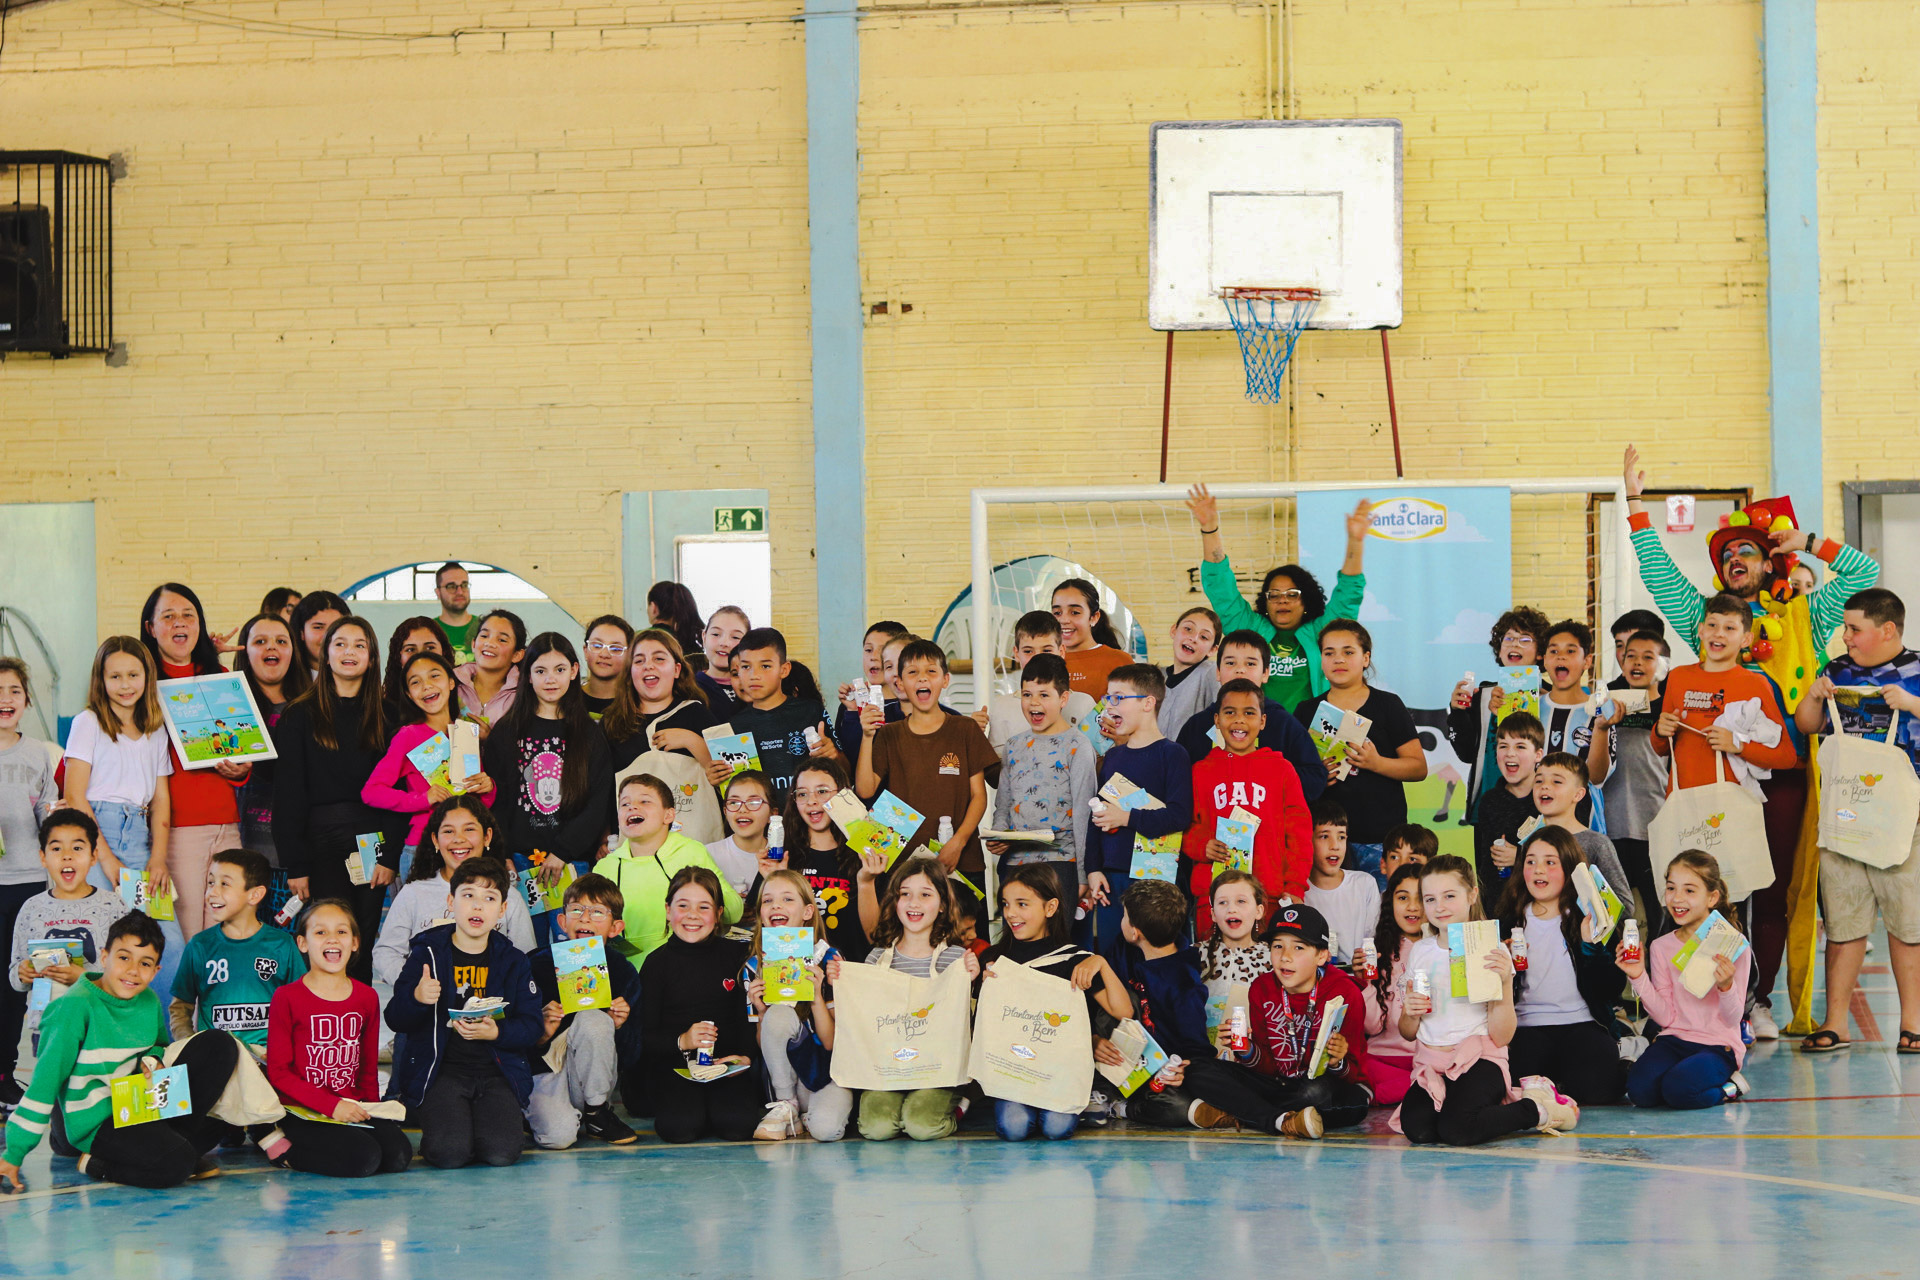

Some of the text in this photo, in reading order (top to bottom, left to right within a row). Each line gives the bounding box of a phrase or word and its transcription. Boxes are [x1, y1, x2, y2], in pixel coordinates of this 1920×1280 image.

[1367, 511, 1444, 526] anta Clara
[1270, 655, 1307, 664] ntando
[1684, 690, 1713, 701] EVERY
[1683, 700, 1712, 709] THING
[1213, 781, 1267, 810] GAP
[805, 875, 850, 892] NTE
[44, 919, 65, 928] NEXT
[205, 958, 229, 985] 28
[1002, 1005, 1043, 1021] Plantando
[311, 1011, 363, 1044] DO
[901, 1017, 928, 1041] Bem
[1030, 1020, 1058, 1044] Bem
